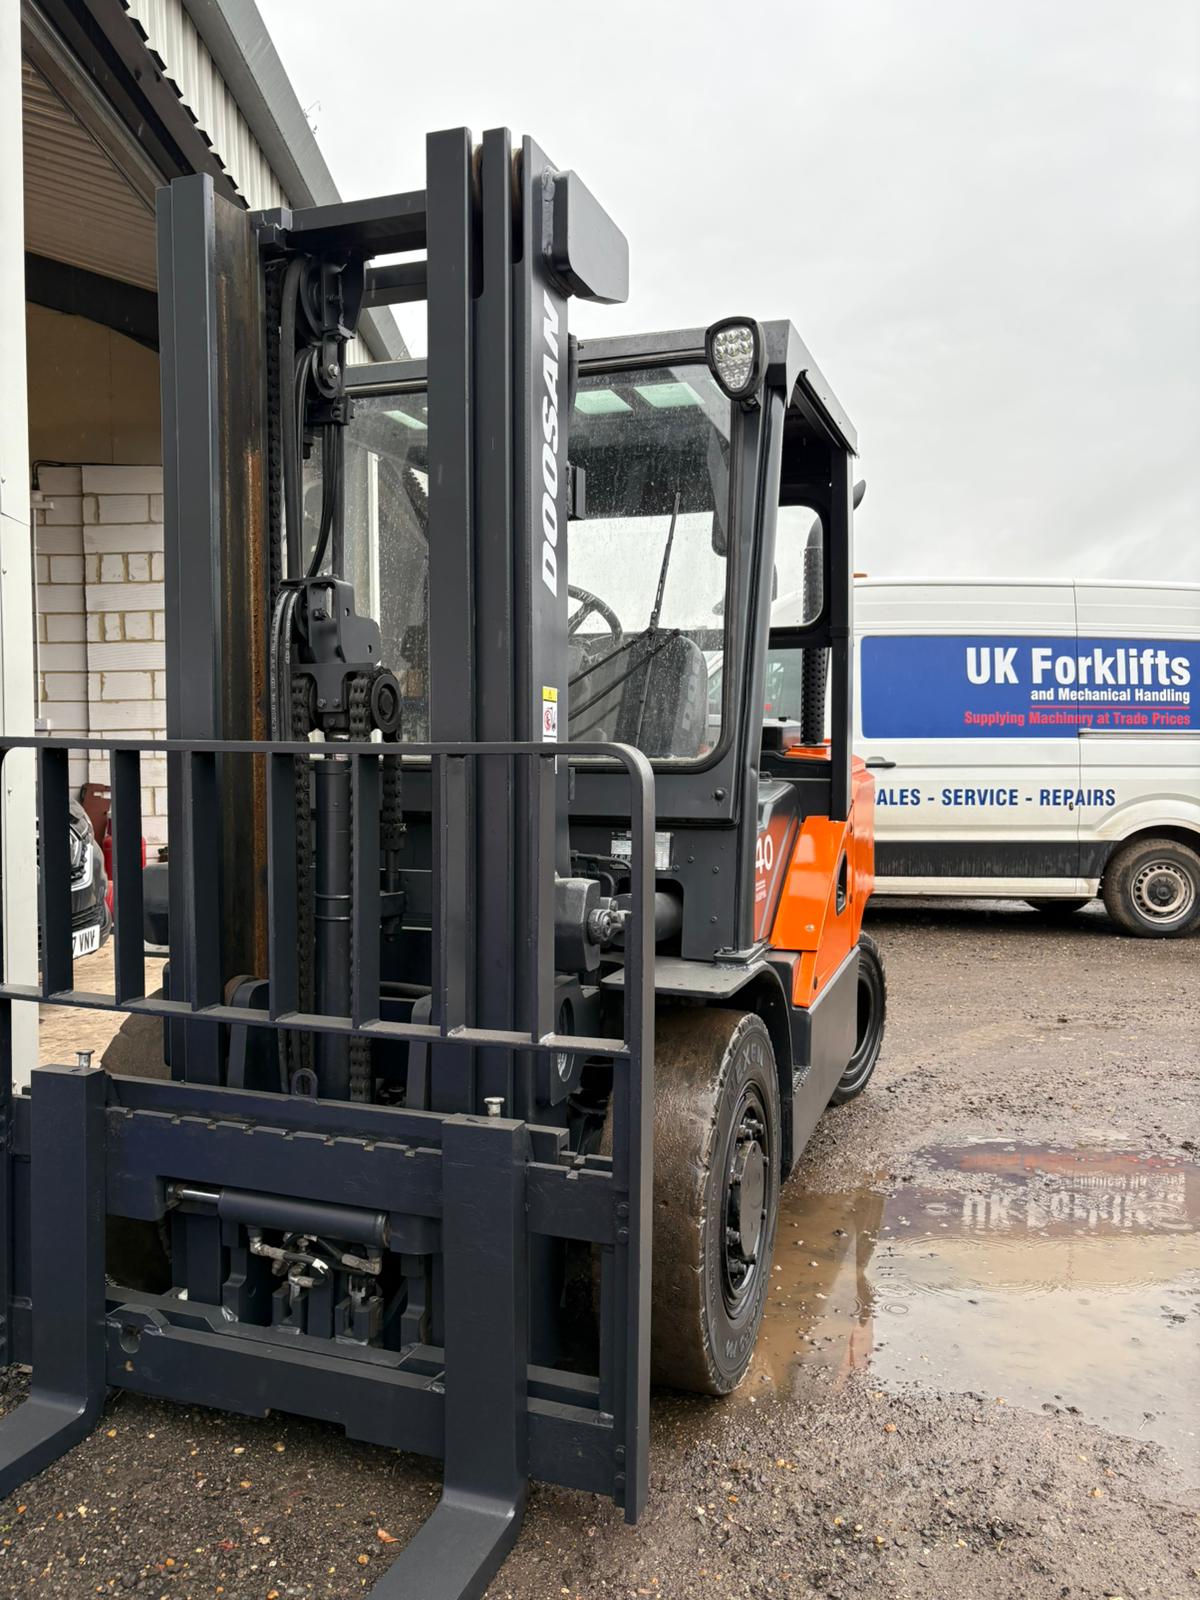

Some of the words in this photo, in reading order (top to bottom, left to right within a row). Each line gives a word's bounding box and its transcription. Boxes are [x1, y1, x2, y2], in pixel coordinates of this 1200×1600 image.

[541, 289, 559, 598] DOOSAN
[966, 646, 1019, 685] UK
[1031, 647, 1191, 686] Forklifts
[1030, 687, 1055, 702] and
[1058, 688, 1131, 703] Mechanical
[1134, 688, 1190, 705] Handling
[964, 711, 1025, 727] Supplying
[1028, 711, 1093, 727] Machinery
[1097, 712, 1109, 725] at
[1113, 712, 1148, 725] Trade
[1152, 711, 1190, 726] Prices
[873, 788, 921, 806] ALES
[941, 788, 1018, 806] SERVICE
[1039, 788, 1116, 807] REPAIRS
